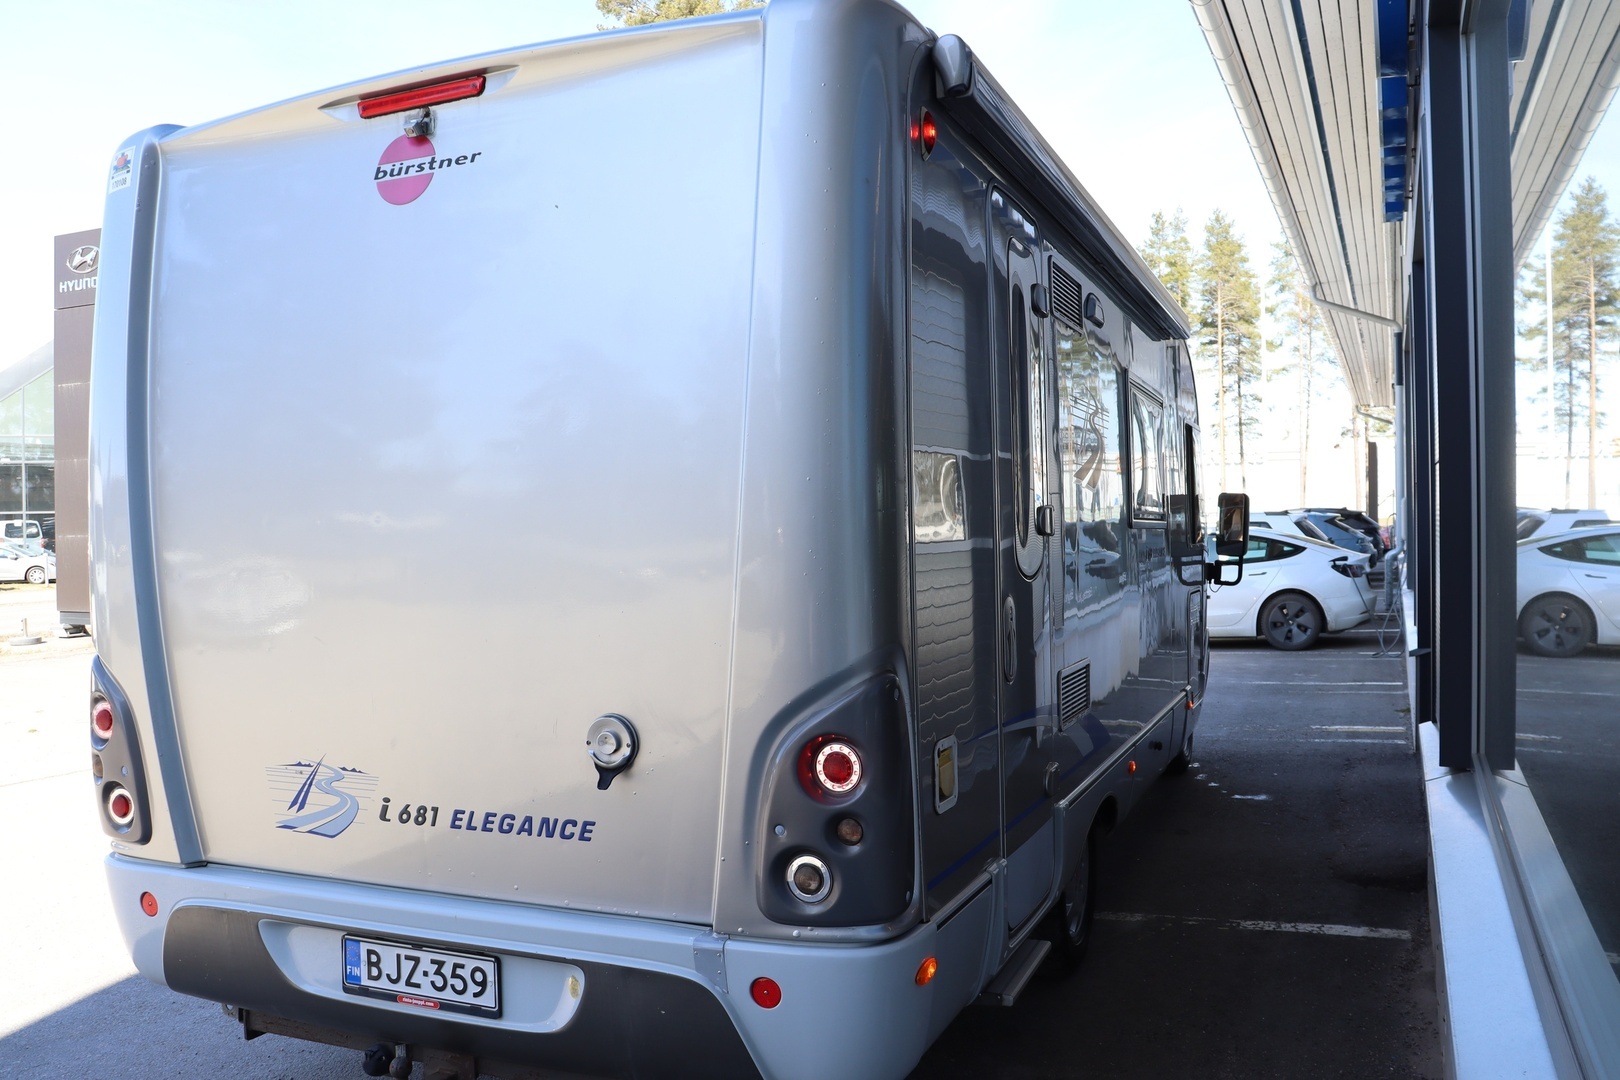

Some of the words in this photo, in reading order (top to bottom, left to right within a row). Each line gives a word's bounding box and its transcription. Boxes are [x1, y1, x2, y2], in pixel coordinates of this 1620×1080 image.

[374, 152, 482, 181] bürstner
[59, 276, 98, 293] HYUND
[397, 803, 439, 827] 681
[450, 809, 596, 841] ELEGANCE
[347, 966, 360, 976] FIN
[367, 949, 487, 998] BJZ-359
